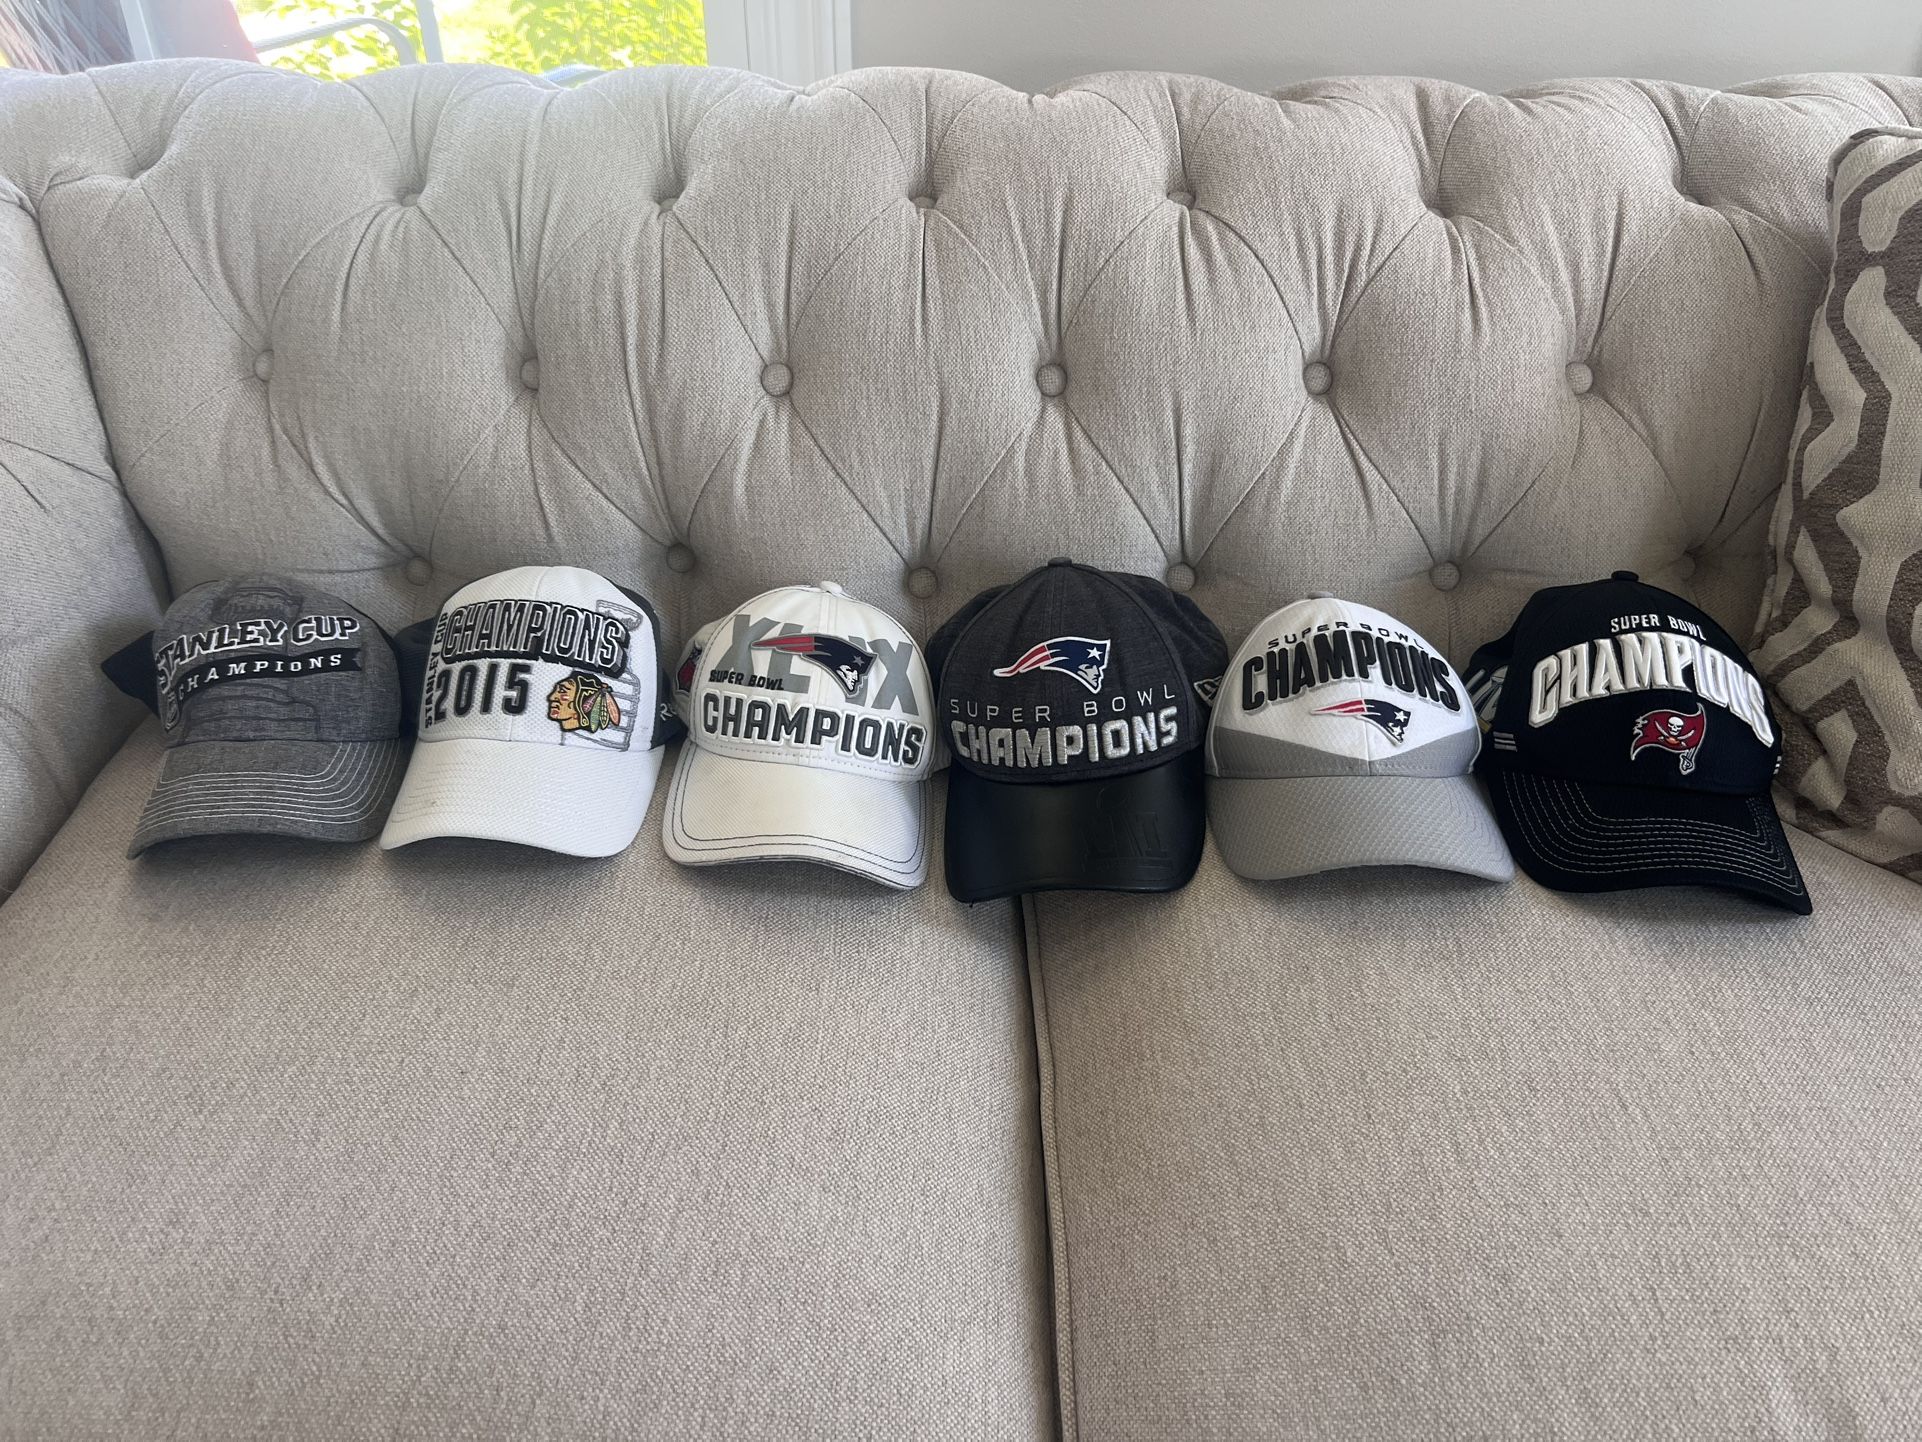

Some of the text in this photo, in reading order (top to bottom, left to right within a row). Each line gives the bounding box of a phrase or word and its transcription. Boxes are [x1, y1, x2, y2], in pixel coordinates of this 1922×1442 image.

[156, 615, 360, 694] STANLEY CUP
[442, 599, 630, 678] CHAMPIONS
[1268, 621, 1424, 650] SUPER BOWL
[1610, 613, 1706, 641] SUPER BOWL
[178, 652, 342, 700] CHAMPIONS
[425, 612, 448, 729] STANLEY CUP
[434, 662, 532, 723] 2015
[709, 669, 785, 691] SUPER BOWL
[1242, 629, 1461, 712] CHAMPIONS
[1528, 631, 1774, 748] CHAMPIONS
[702, 689, 926, 767] CHAMPIONS
[950, 684, 1175, 723] SUPER BOWL
[951, 705, 1178, 768] CHAMPIONS
